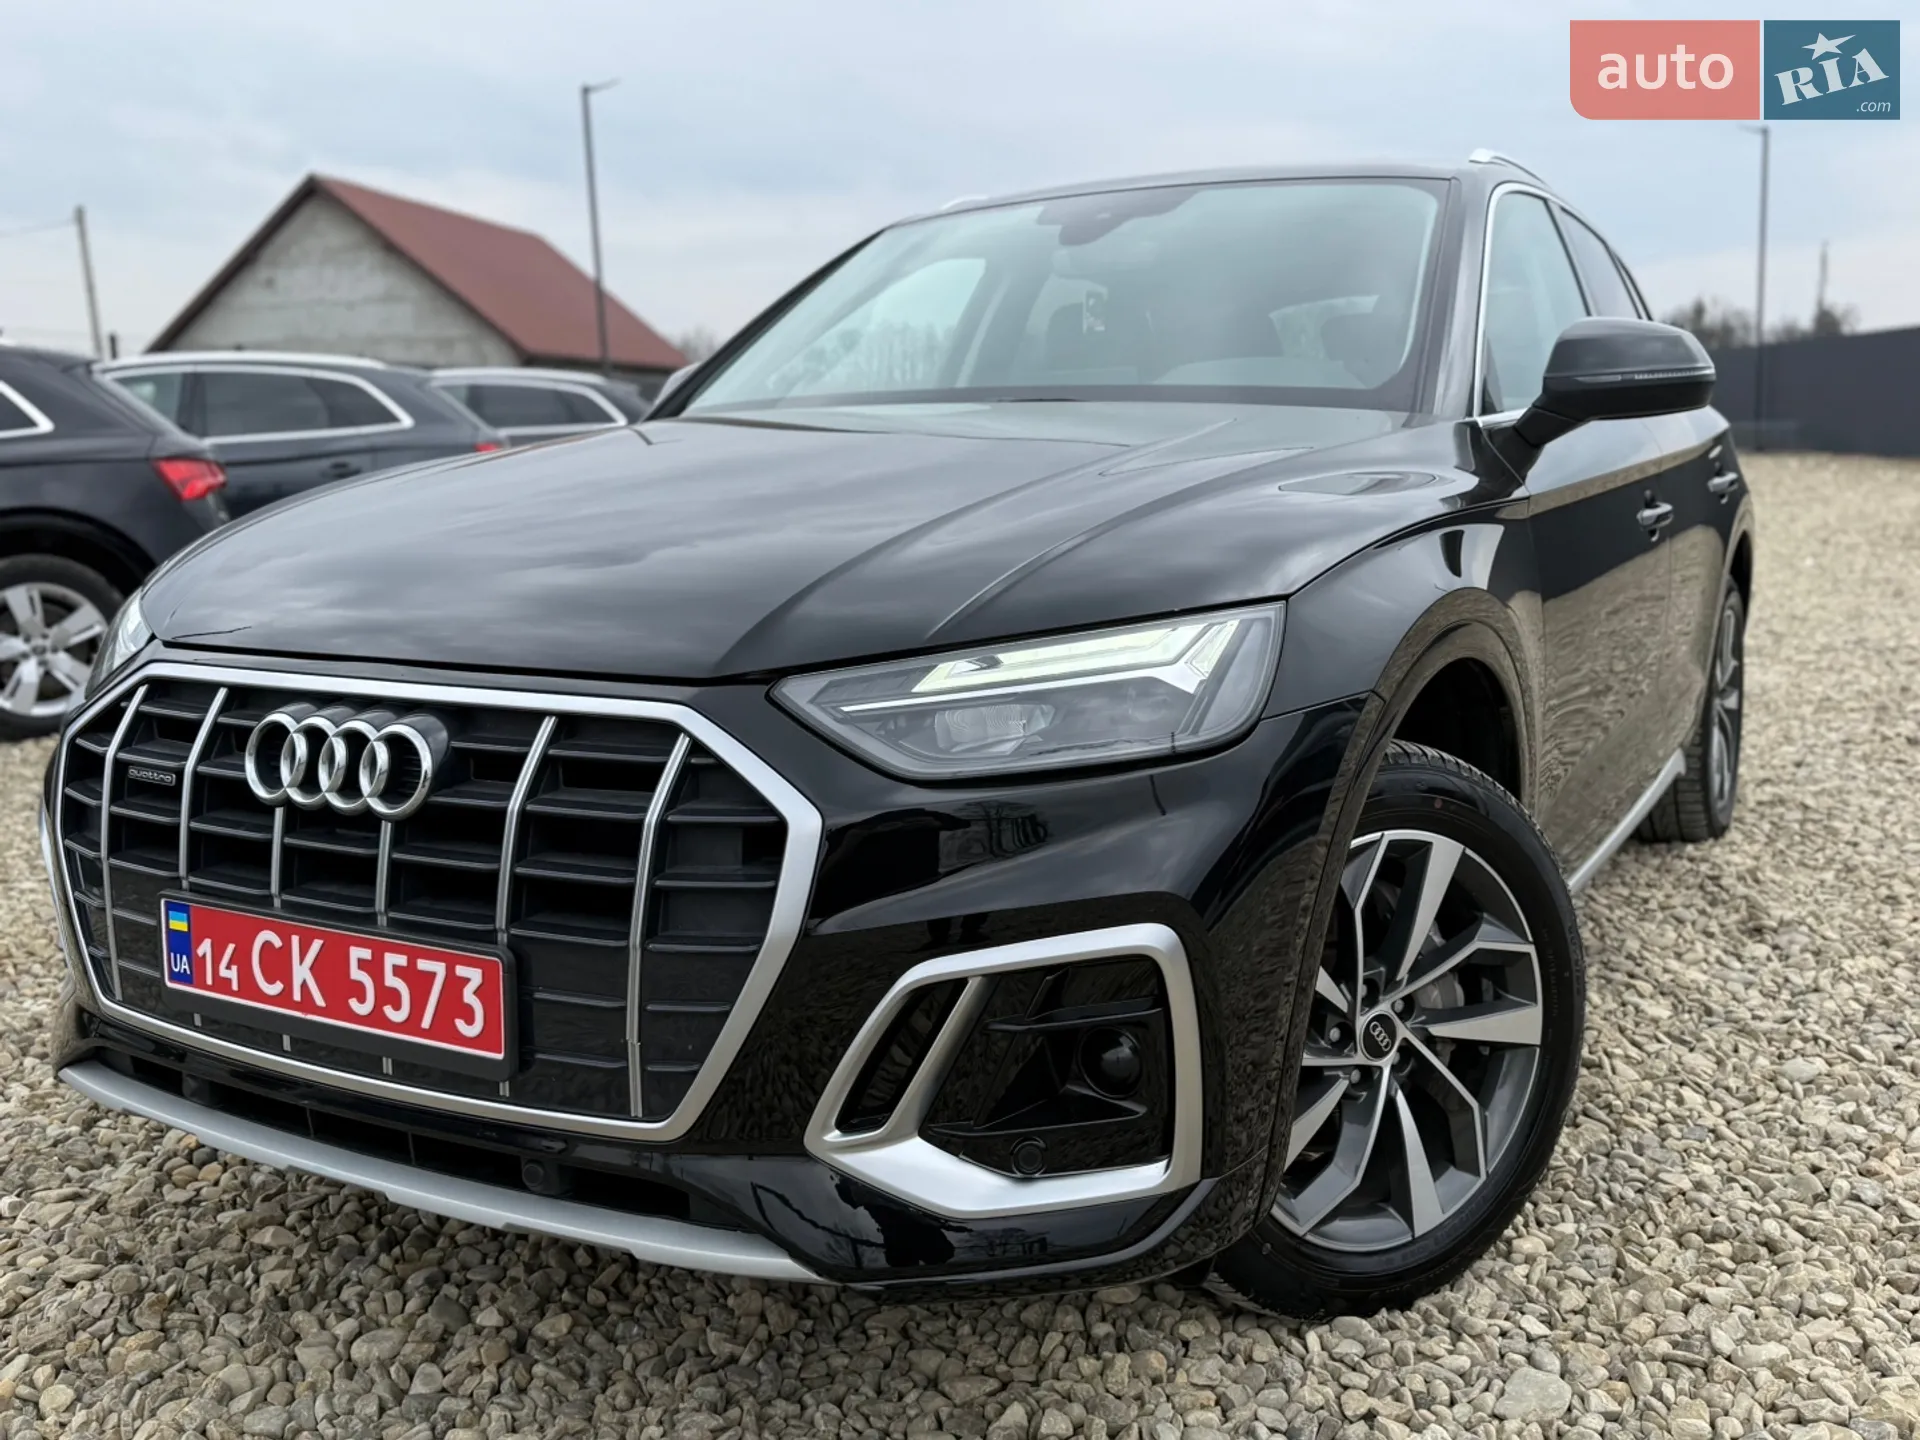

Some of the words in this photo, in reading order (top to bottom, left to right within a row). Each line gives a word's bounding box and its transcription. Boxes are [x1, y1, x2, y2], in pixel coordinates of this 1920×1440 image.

[129, 768, 172, 783] quattro
[170, 952, 190, 975] UA
[196, 938, 239, 991] 14
[251, 930, 326, 1007] CK
[348, 945, 485, 1038] 5573
